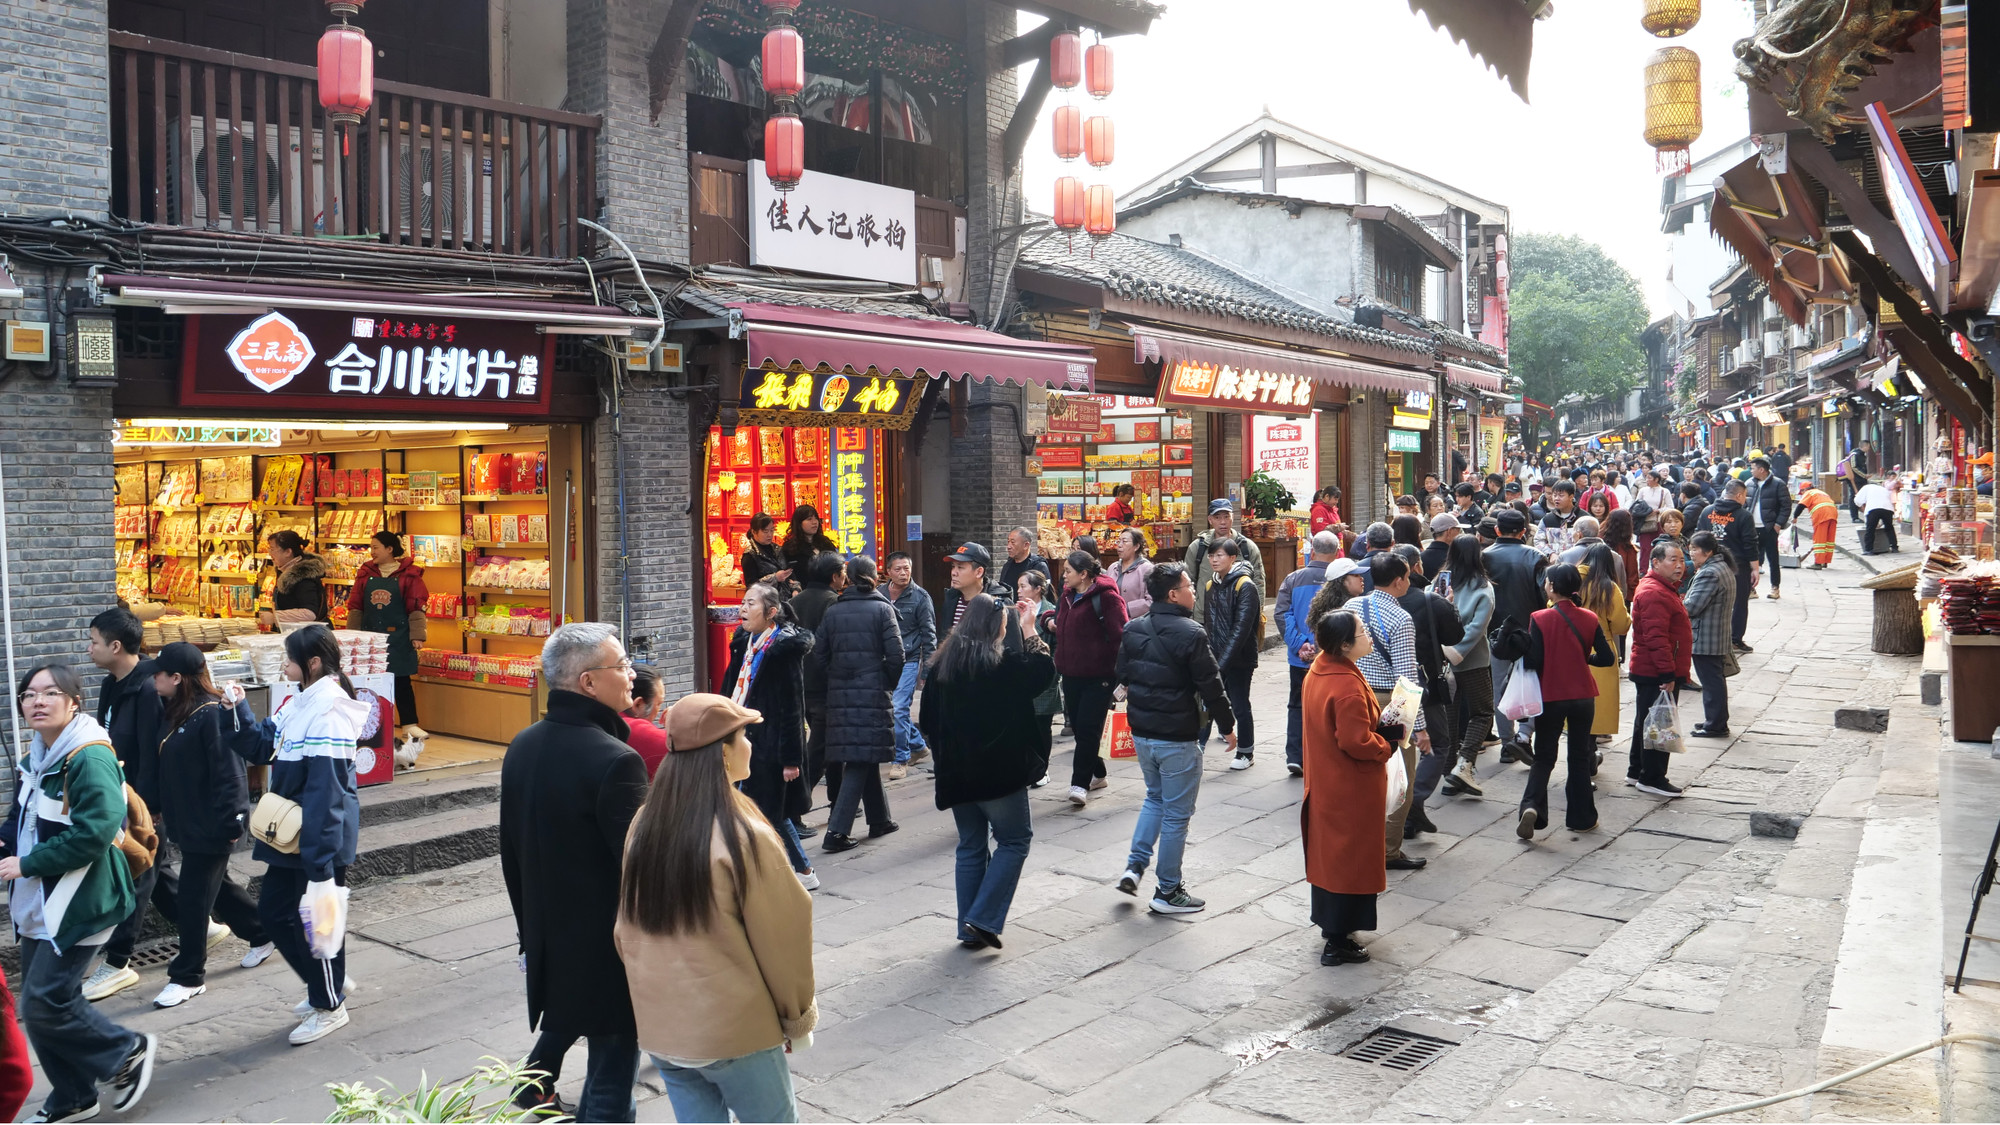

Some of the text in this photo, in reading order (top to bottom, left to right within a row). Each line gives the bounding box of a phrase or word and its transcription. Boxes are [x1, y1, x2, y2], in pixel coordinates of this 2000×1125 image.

[765, 199, 907, 252] 佳人记旅拍
[241, 340, 304, 364] 三民斋
[324, 342, 517, 399] 合川桃片
[515, 354, 539, 396] 总店
[1179, 366, 1212, 390] 陈建平
[1269, 428, 1298, 440] 陈建平
[1260, 457, 1310, 472] 重庆麻花
[844, 452, 867, 555] 中华老字号
[1115, 739, 1135, 751] 重庆
